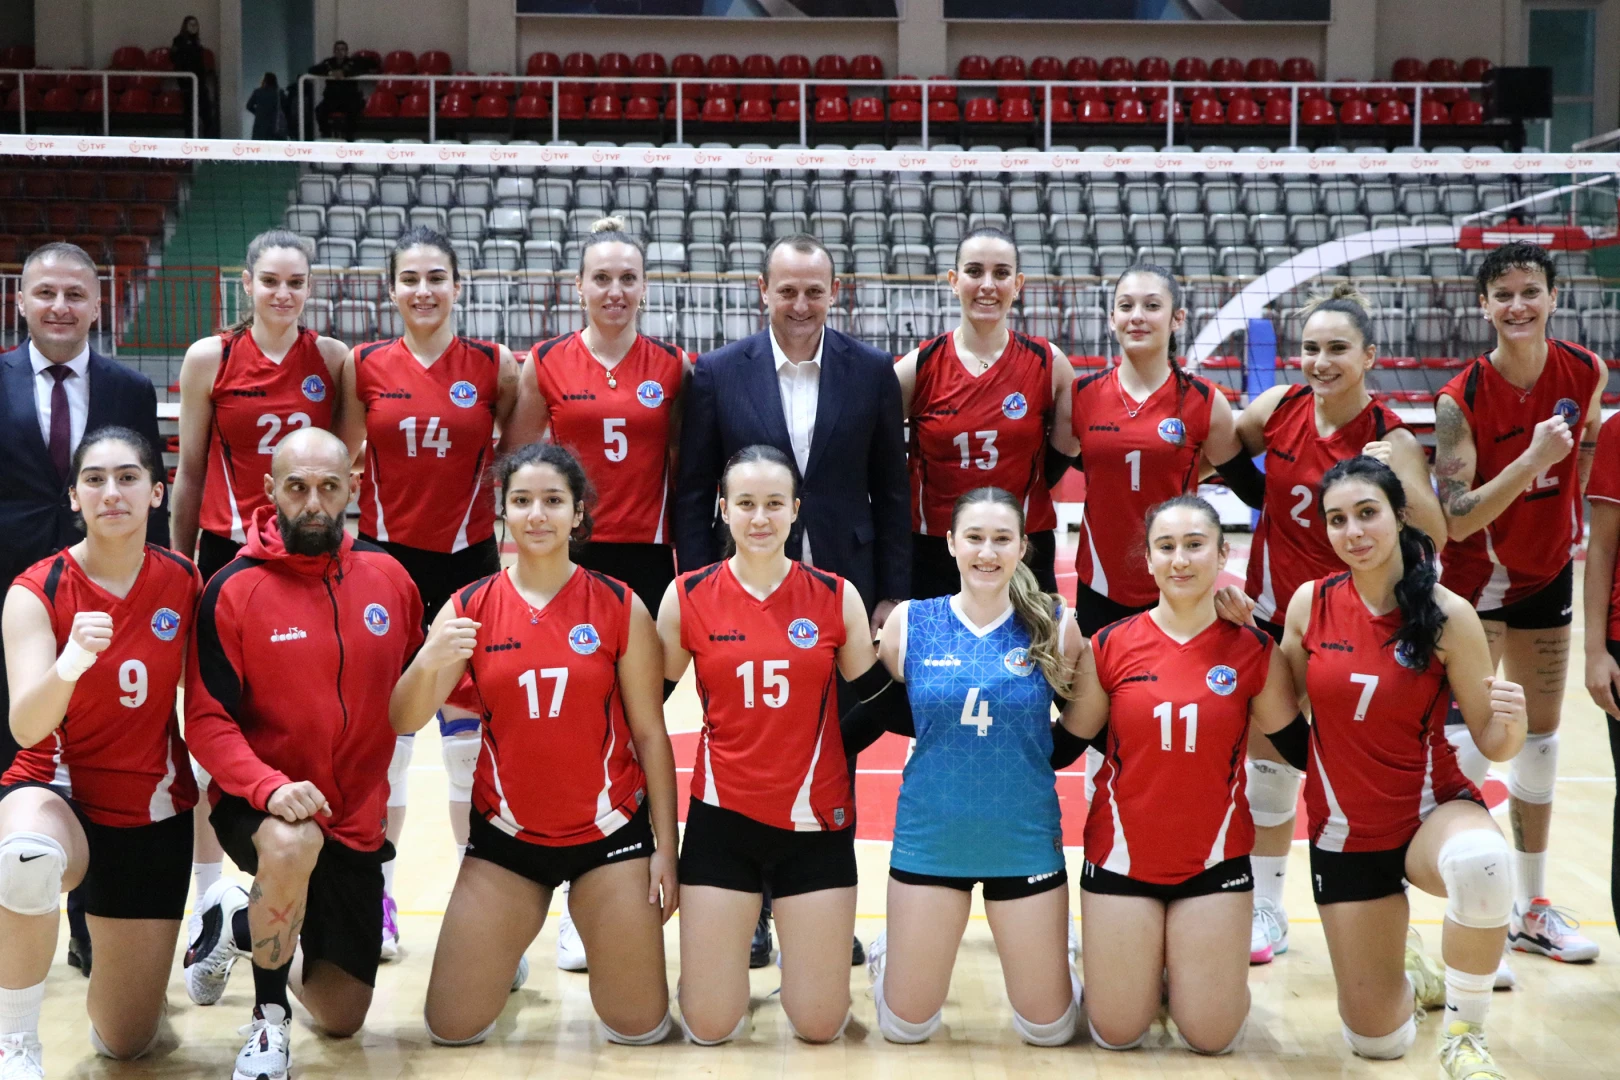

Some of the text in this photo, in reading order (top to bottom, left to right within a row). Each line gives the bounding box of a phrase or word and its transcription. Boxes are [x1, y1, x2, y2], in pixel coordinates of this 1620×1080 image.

[399, 416, 451, 458] 14
[603, 418, 628, 462] 5
[953, 430, 999, 470] 13
[1125, 450, 1141, 491] 1
[1290, 485, 1312, 528] 2
[271, 627, 307, 642] diadora
[118, 659, 148, 708] 9
[518, 667, 568, 719] 17
[736, 659, 790, 708] 15
[1350, 672, 1379, 721] 7
[960, 688, 993, 736] 4
[1153, 701, 1198, 752] 11
